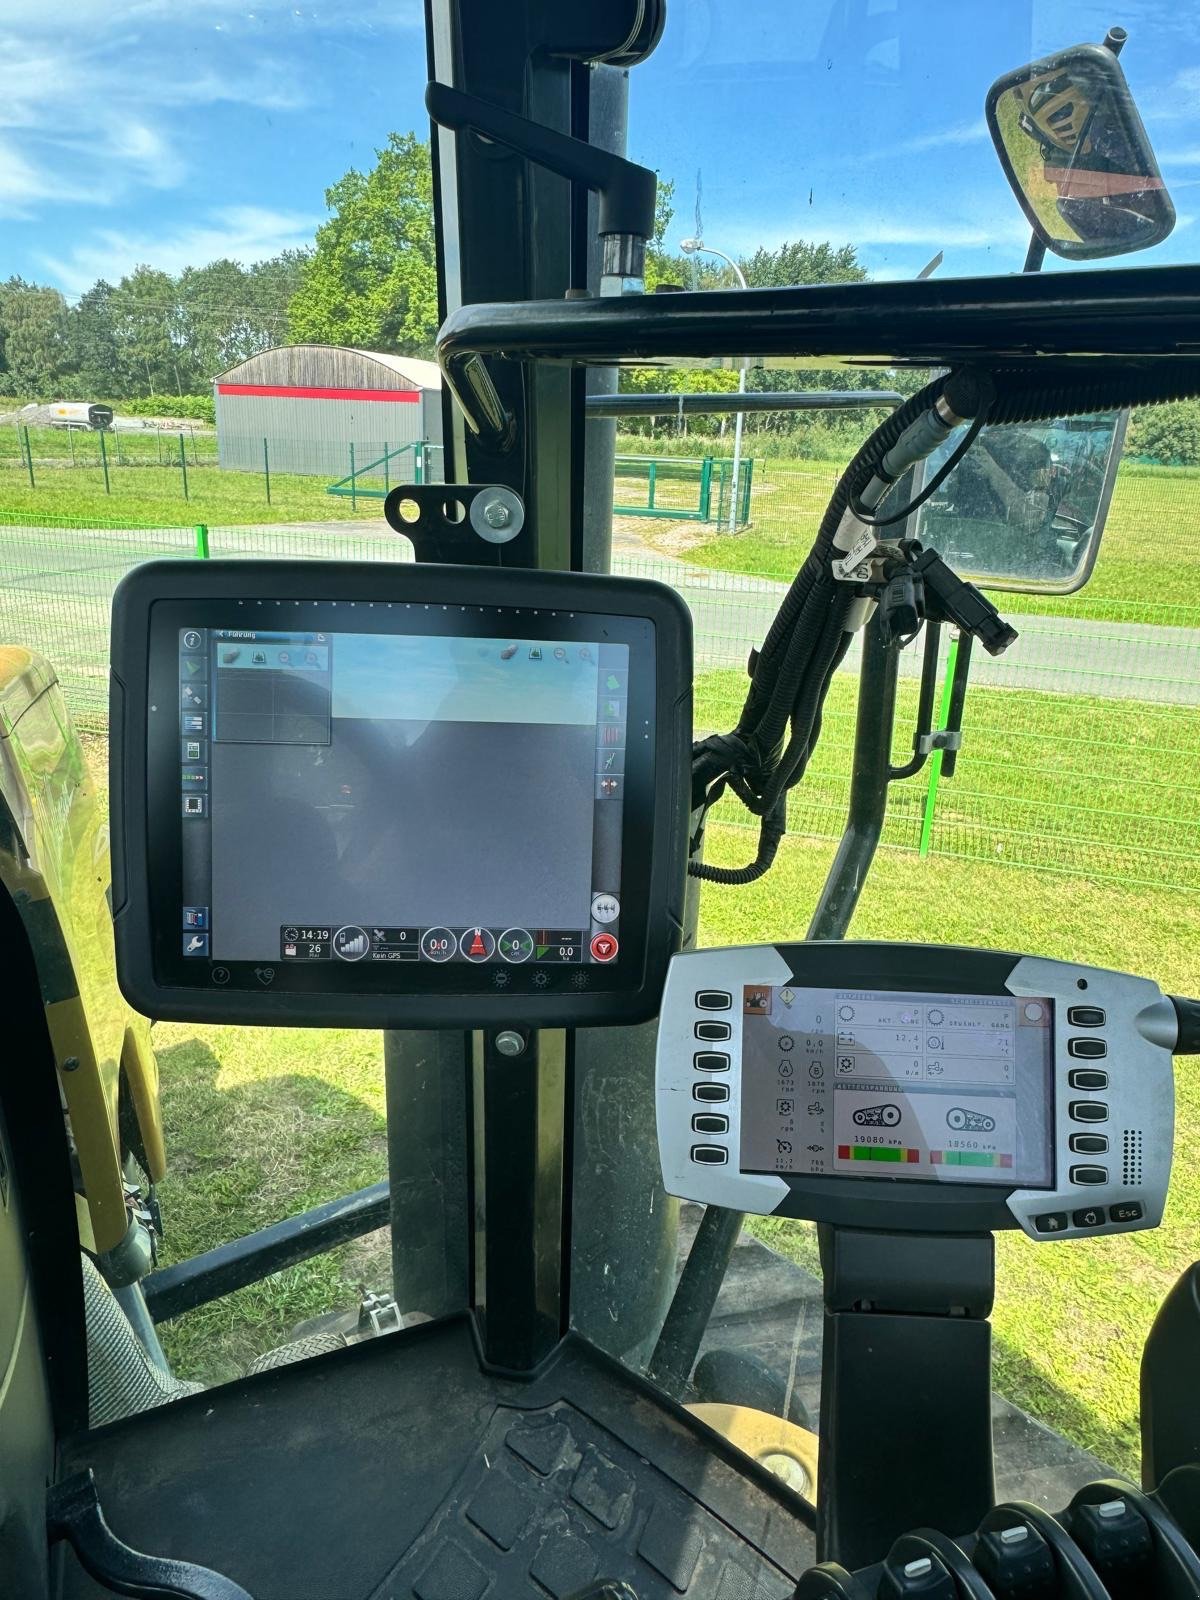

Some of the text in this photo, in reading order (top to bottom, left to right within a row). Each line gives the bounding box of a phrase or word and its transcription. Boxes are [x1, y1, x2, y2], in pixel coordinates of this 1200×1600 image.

[301, 930, 329, 940] 14:19
[399, 932, 406, 941] 0
[474, 928, 482, 936] N
[308, 943, 321, 953] 26
[511, 939, 520, 951] 0
[559, 946, 574, 956] 0.0
[388, 952, 401, 960] GPS
[854, 1135, 885, 1144] 19080
[1118, 1209, 1138, 1218] Esc
